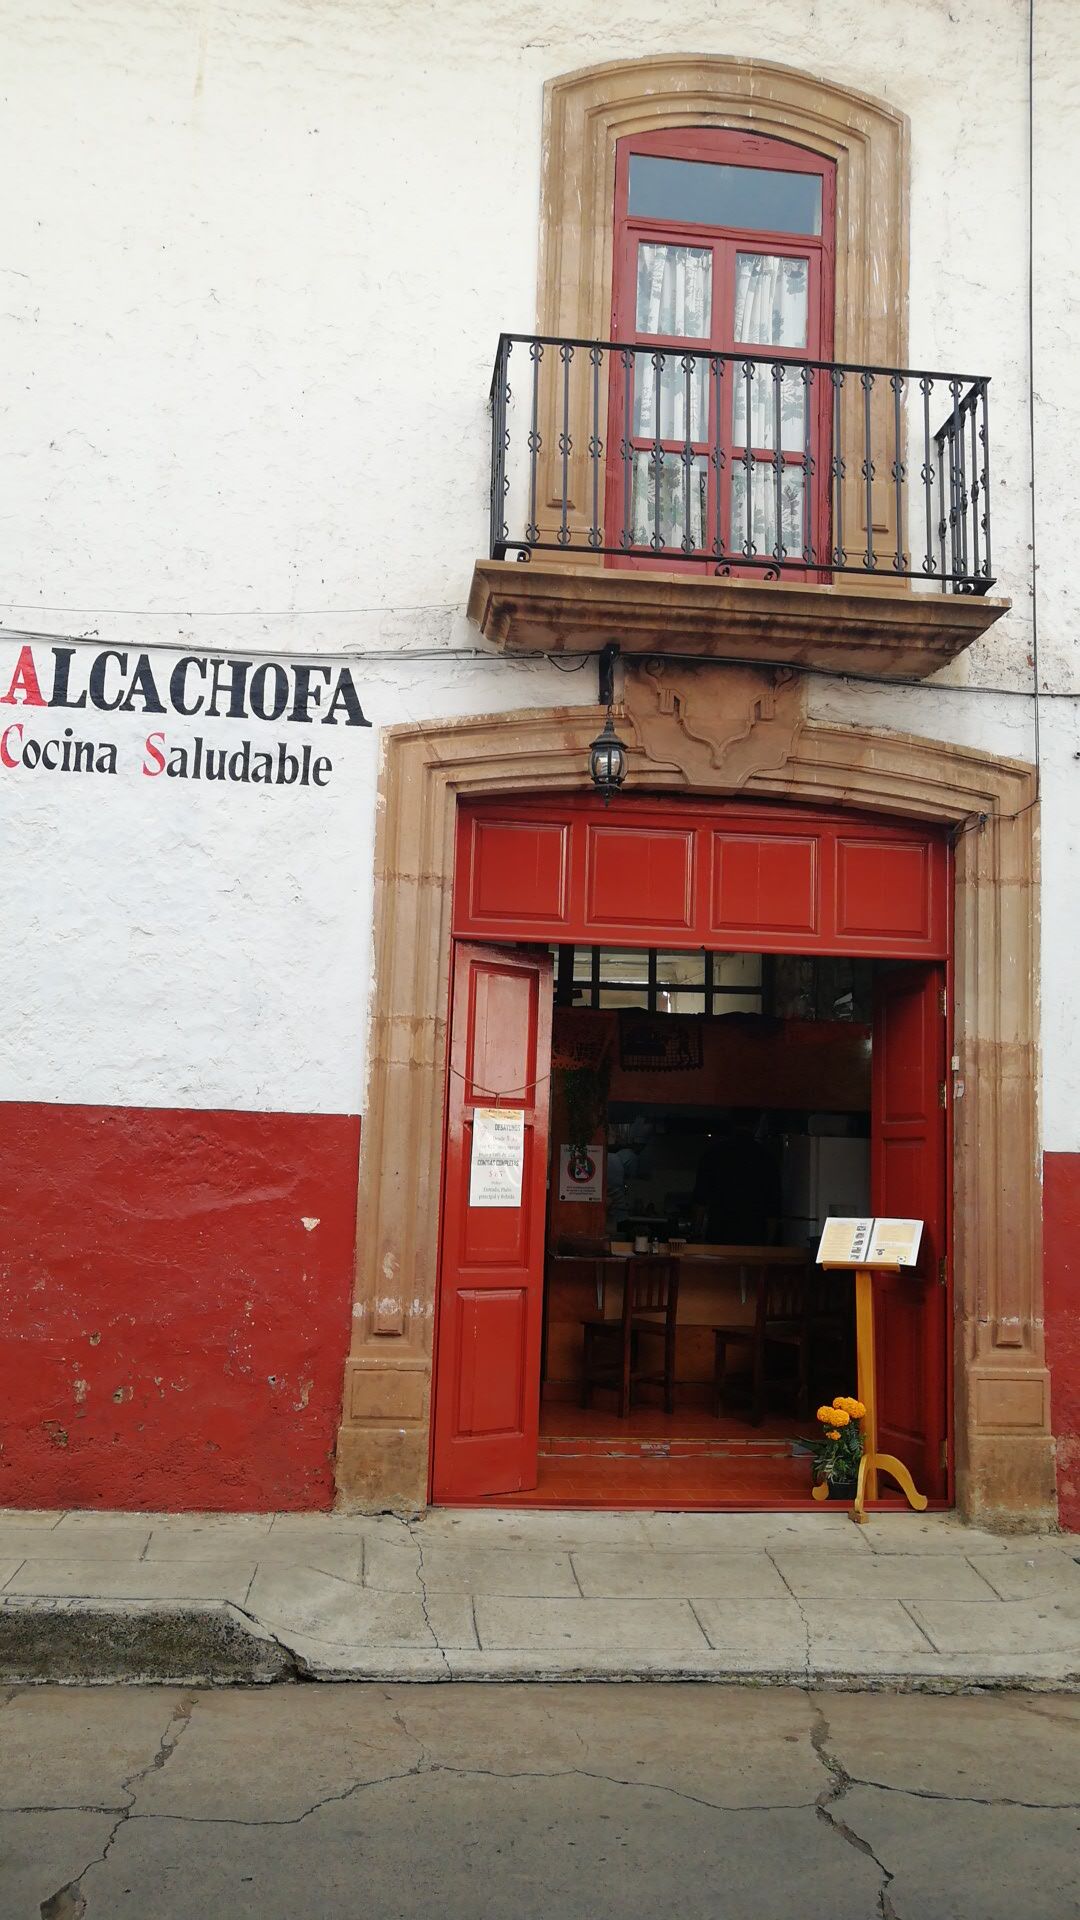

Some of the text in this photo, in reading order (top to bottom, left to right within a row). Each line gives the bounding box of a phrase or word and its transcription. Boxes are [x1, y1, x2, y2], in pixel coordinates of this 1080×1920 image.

[0, 645, 373, 727] ALCACHOFA
[0, 724, 333, 786] Cocina Saludable
